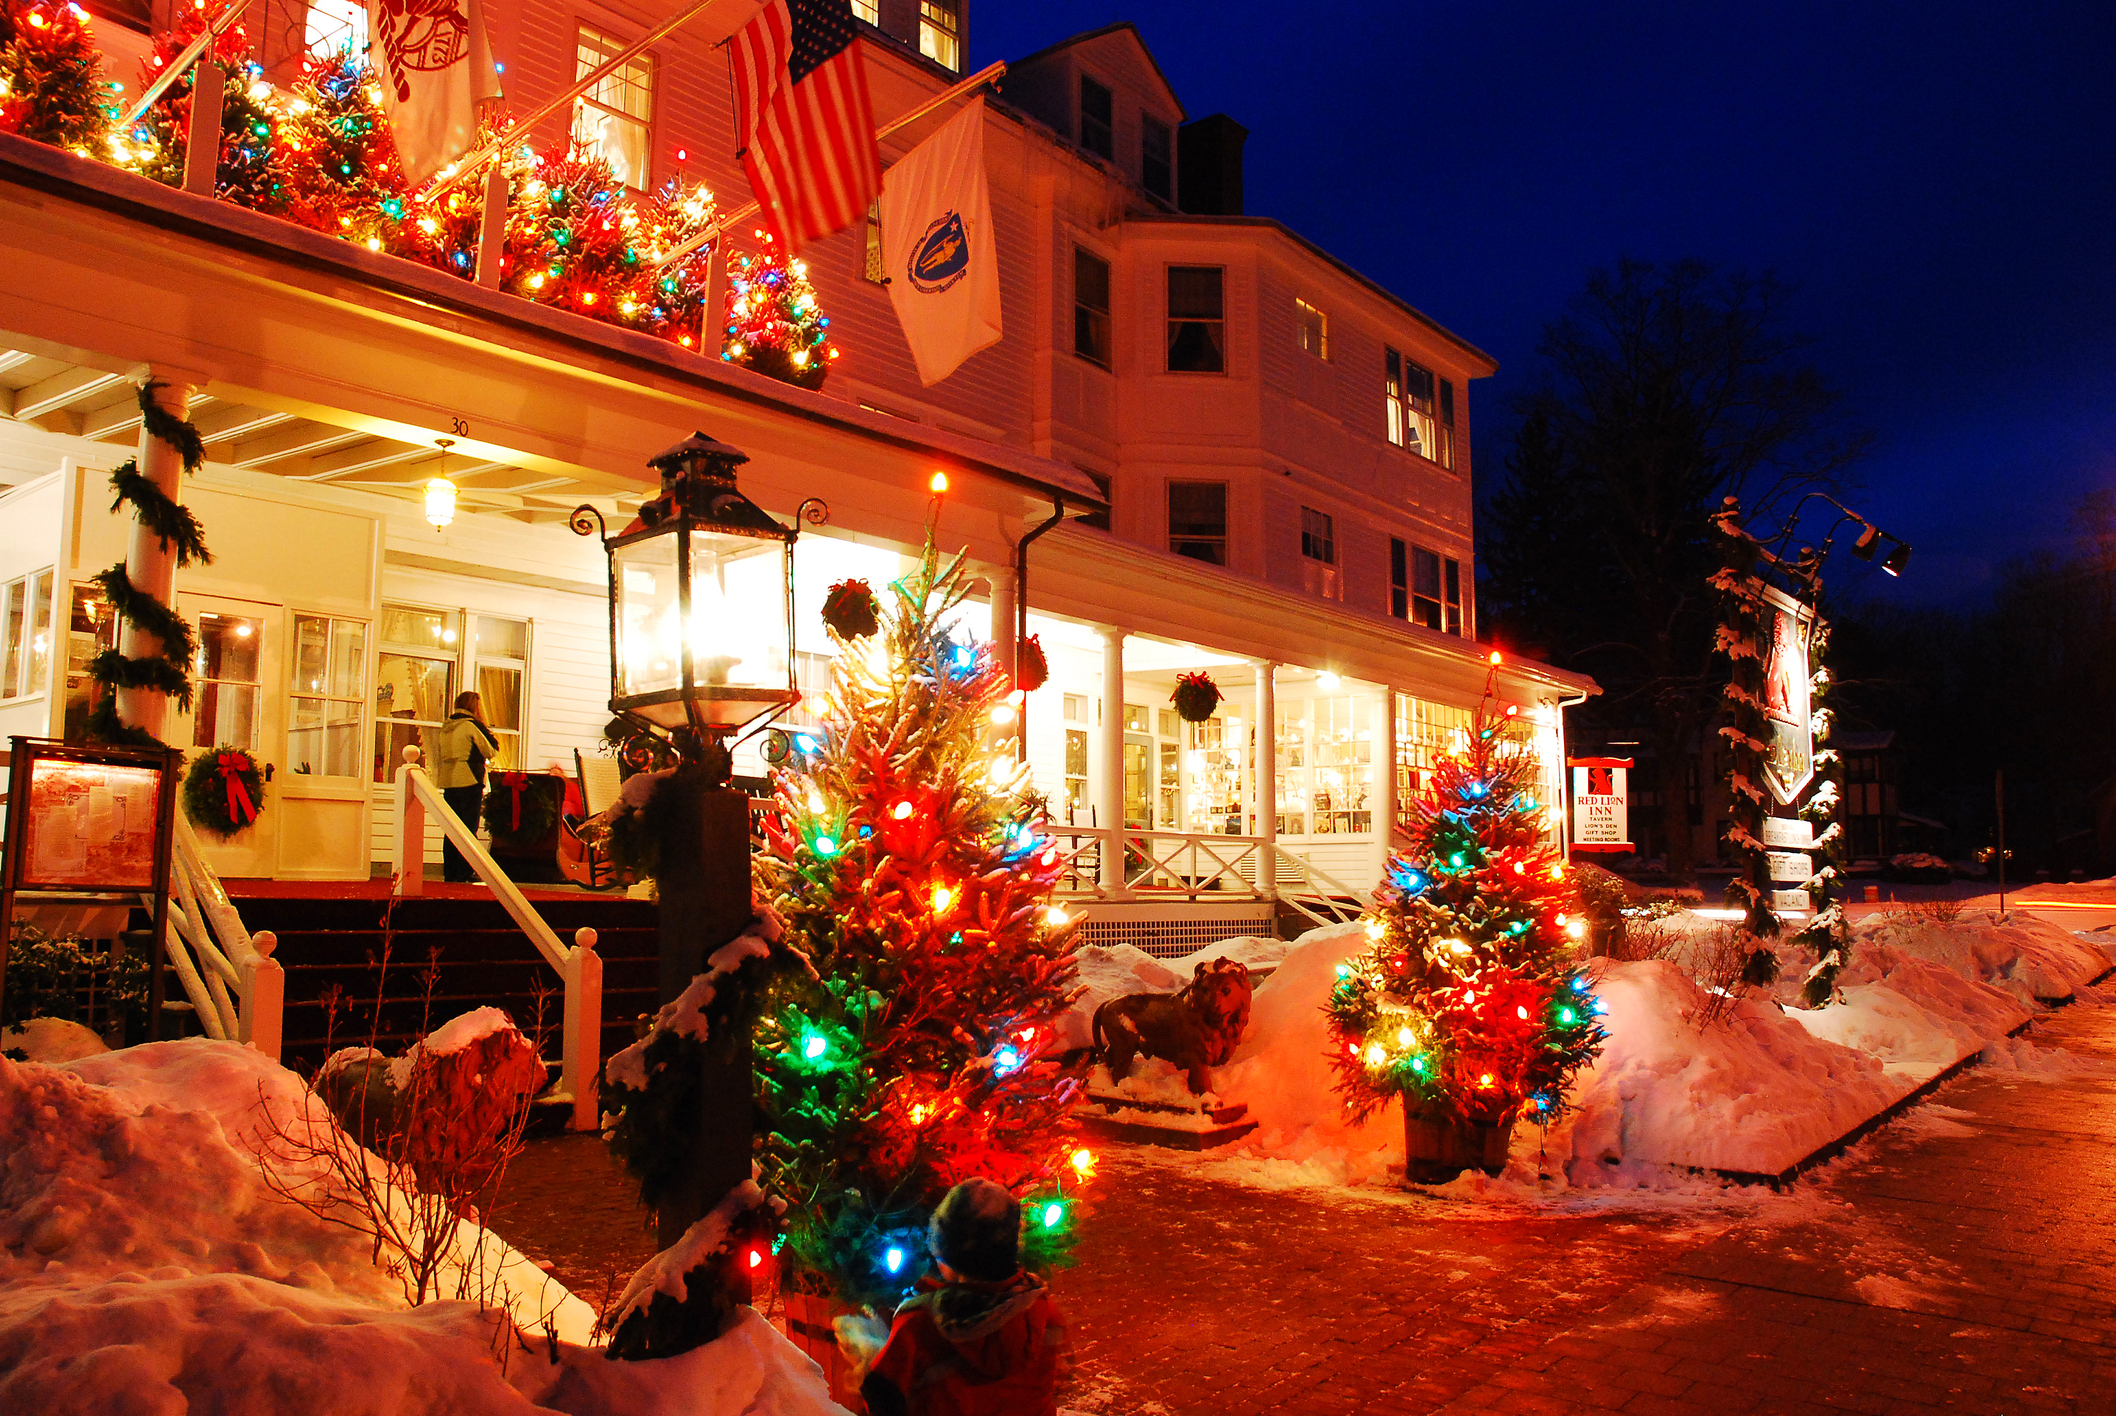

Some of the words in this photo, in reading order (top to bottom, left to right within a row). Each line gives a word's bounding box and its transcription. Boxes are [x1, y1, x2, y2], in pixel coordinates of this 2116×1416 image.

[451, 417, 468, 437] 30
[1578, 796, 1598, 805] RED
[1600, 796, 1624, 805] LION
[1589, 806, 1612, 815] INN
[1789, 861, 1808, 875] SHOPS
